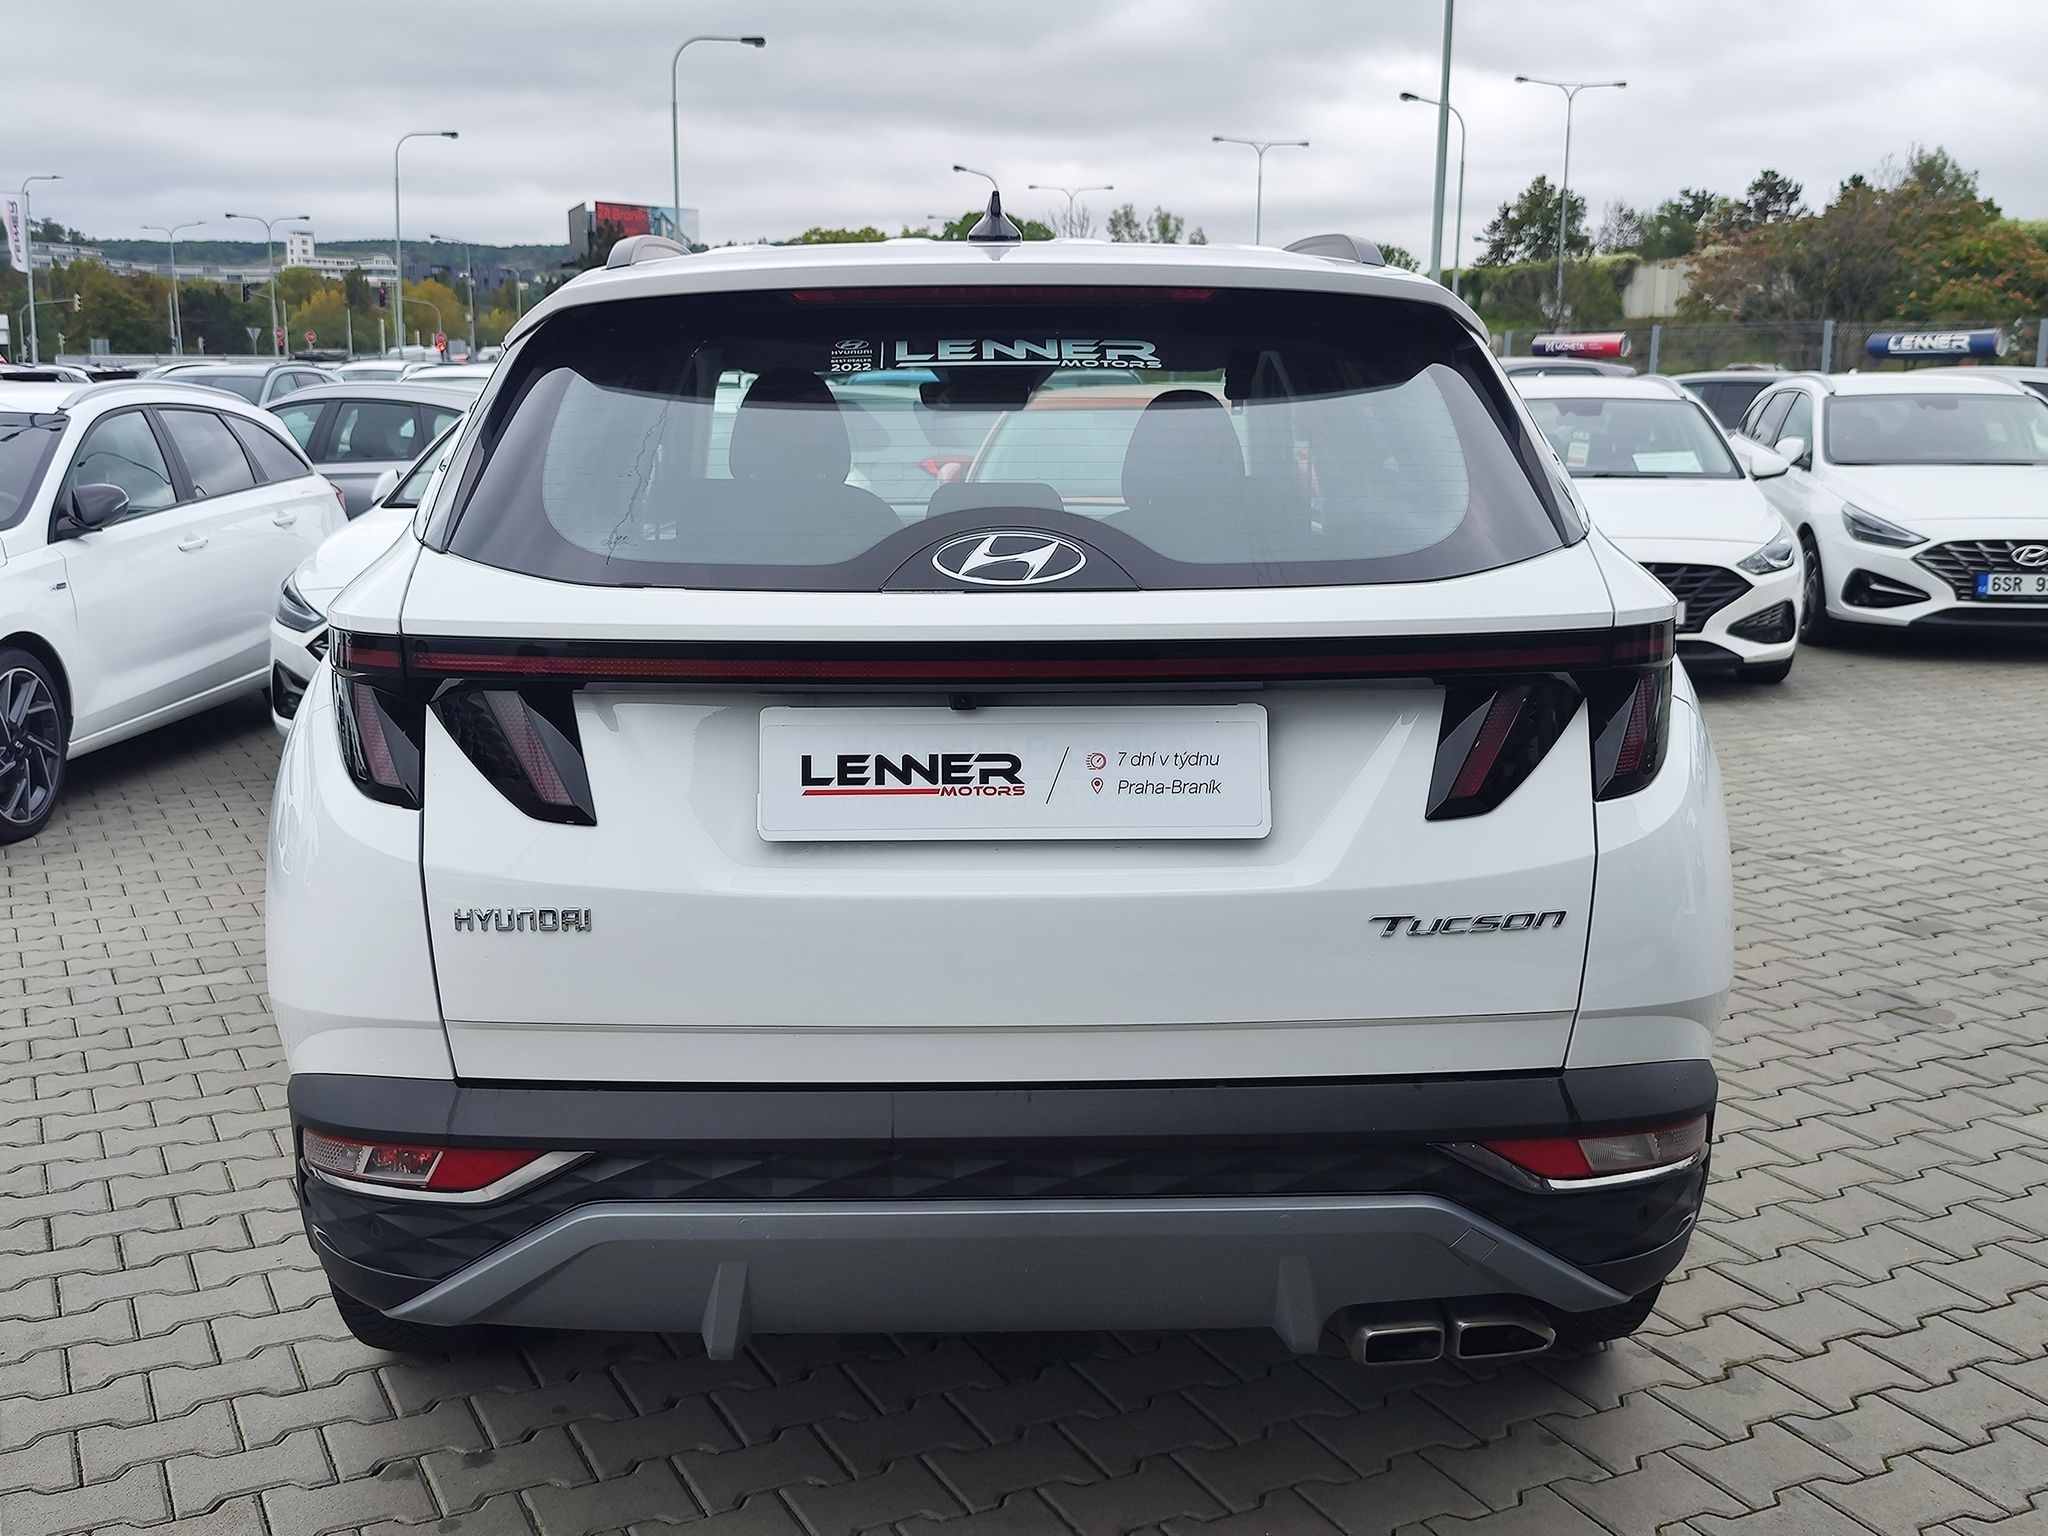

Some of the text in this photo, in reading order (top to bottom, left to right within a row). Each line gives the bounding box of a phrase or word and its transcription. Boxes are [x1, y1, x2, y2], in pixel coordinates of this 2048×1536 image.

[896, 339, 1160, 361] LENNER
[1888, 334, 1971, 351] LENNER
[830, 363, 872, 372] 2022
[1060, 360, 1162, 369] MOTORS
[1992, 576, 2023, 592] 6SR
[2035, 577, 2048, 592] 9
[1117, 751, 1220, 770] 7 dní v týdnu
[800, 753, 1025, 787] LENNER
[940, 786, 1026, 797] MOTORS
[1117, 779, 1222, 795] Praha-Braník
[453, 907, 593, 933] HYUNDAI
